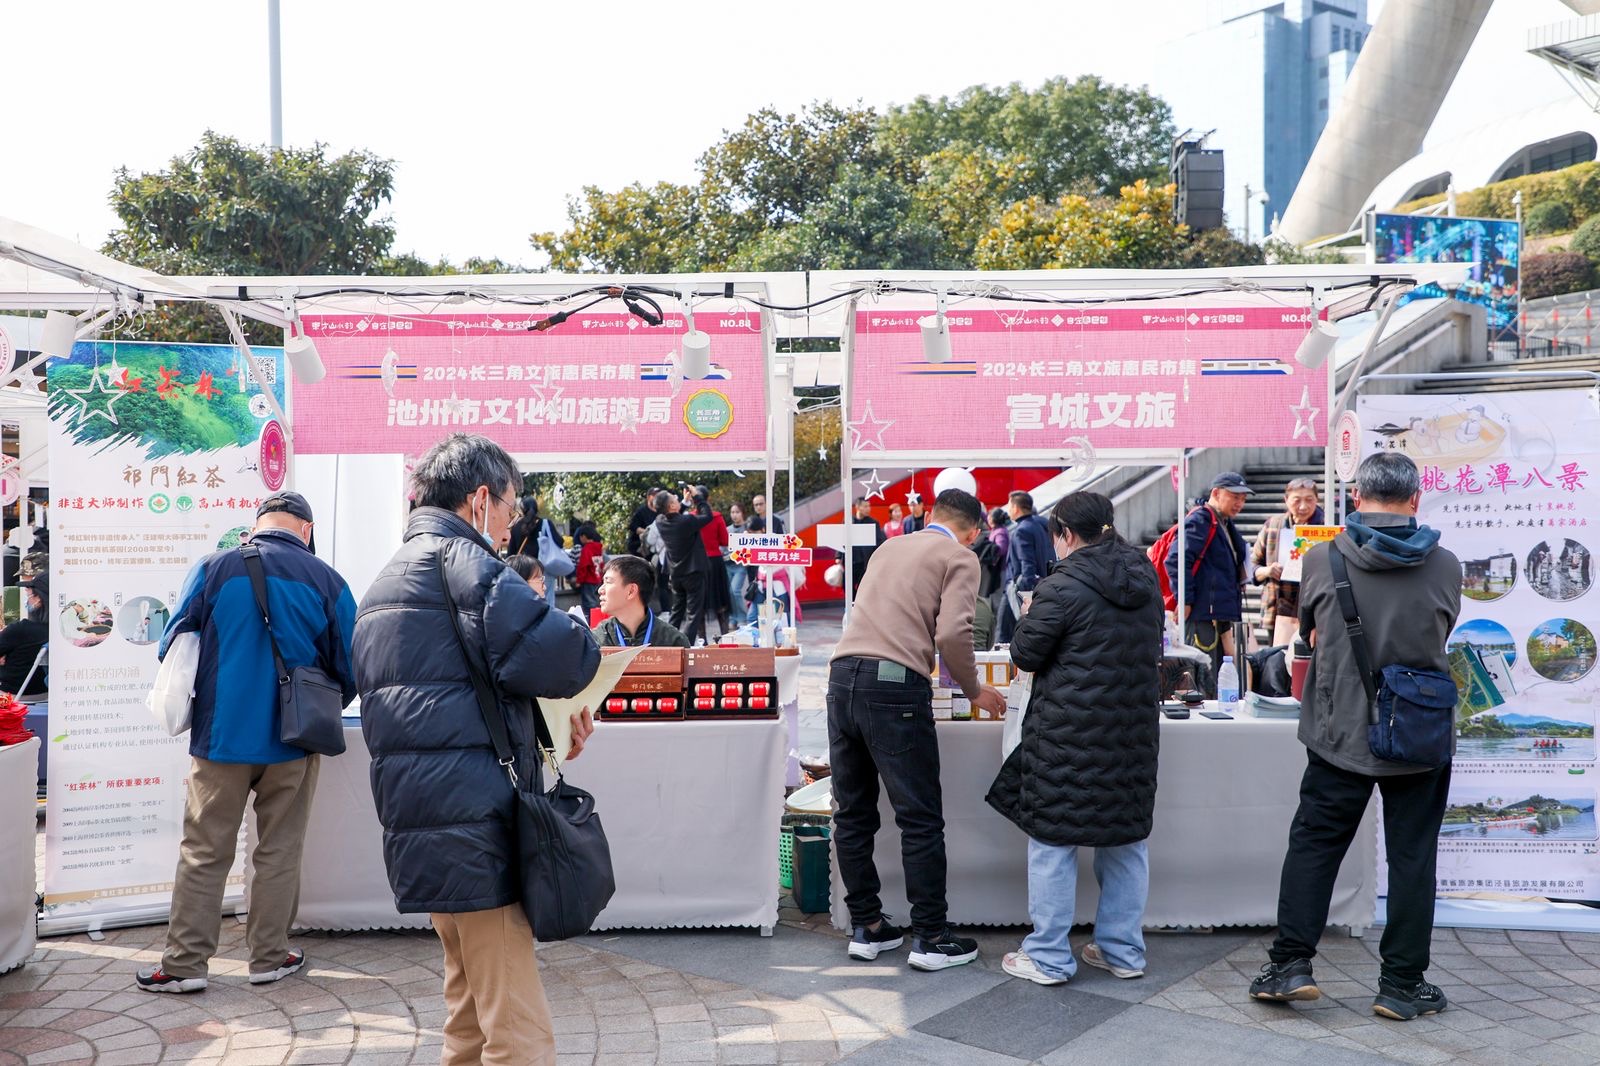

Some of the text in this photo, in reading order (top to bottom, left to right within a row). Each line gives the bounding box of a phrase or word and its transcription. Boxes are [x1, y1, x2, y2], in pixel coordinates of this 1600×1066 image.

[720, 319, 751, 328] NO.88
[423, 364, 636, 382] 2024长三角文旅惠民市集
[983, 360, 1197, 378] 2024长三角文旅惠民市集
[387, 396, 672, 427] 池州市文化和旅游局
[1005, 391, 1177, 431] 宣城文旅
[1420, 462, 1589, 494] 桃花潭八景
[738, 537, 779, 546] 山水池州
[757, 551, 800, 562] 灵秀九华
[1437, 879, 1585, 888] 徽省旅游集团泾县旅游发展有限公司
